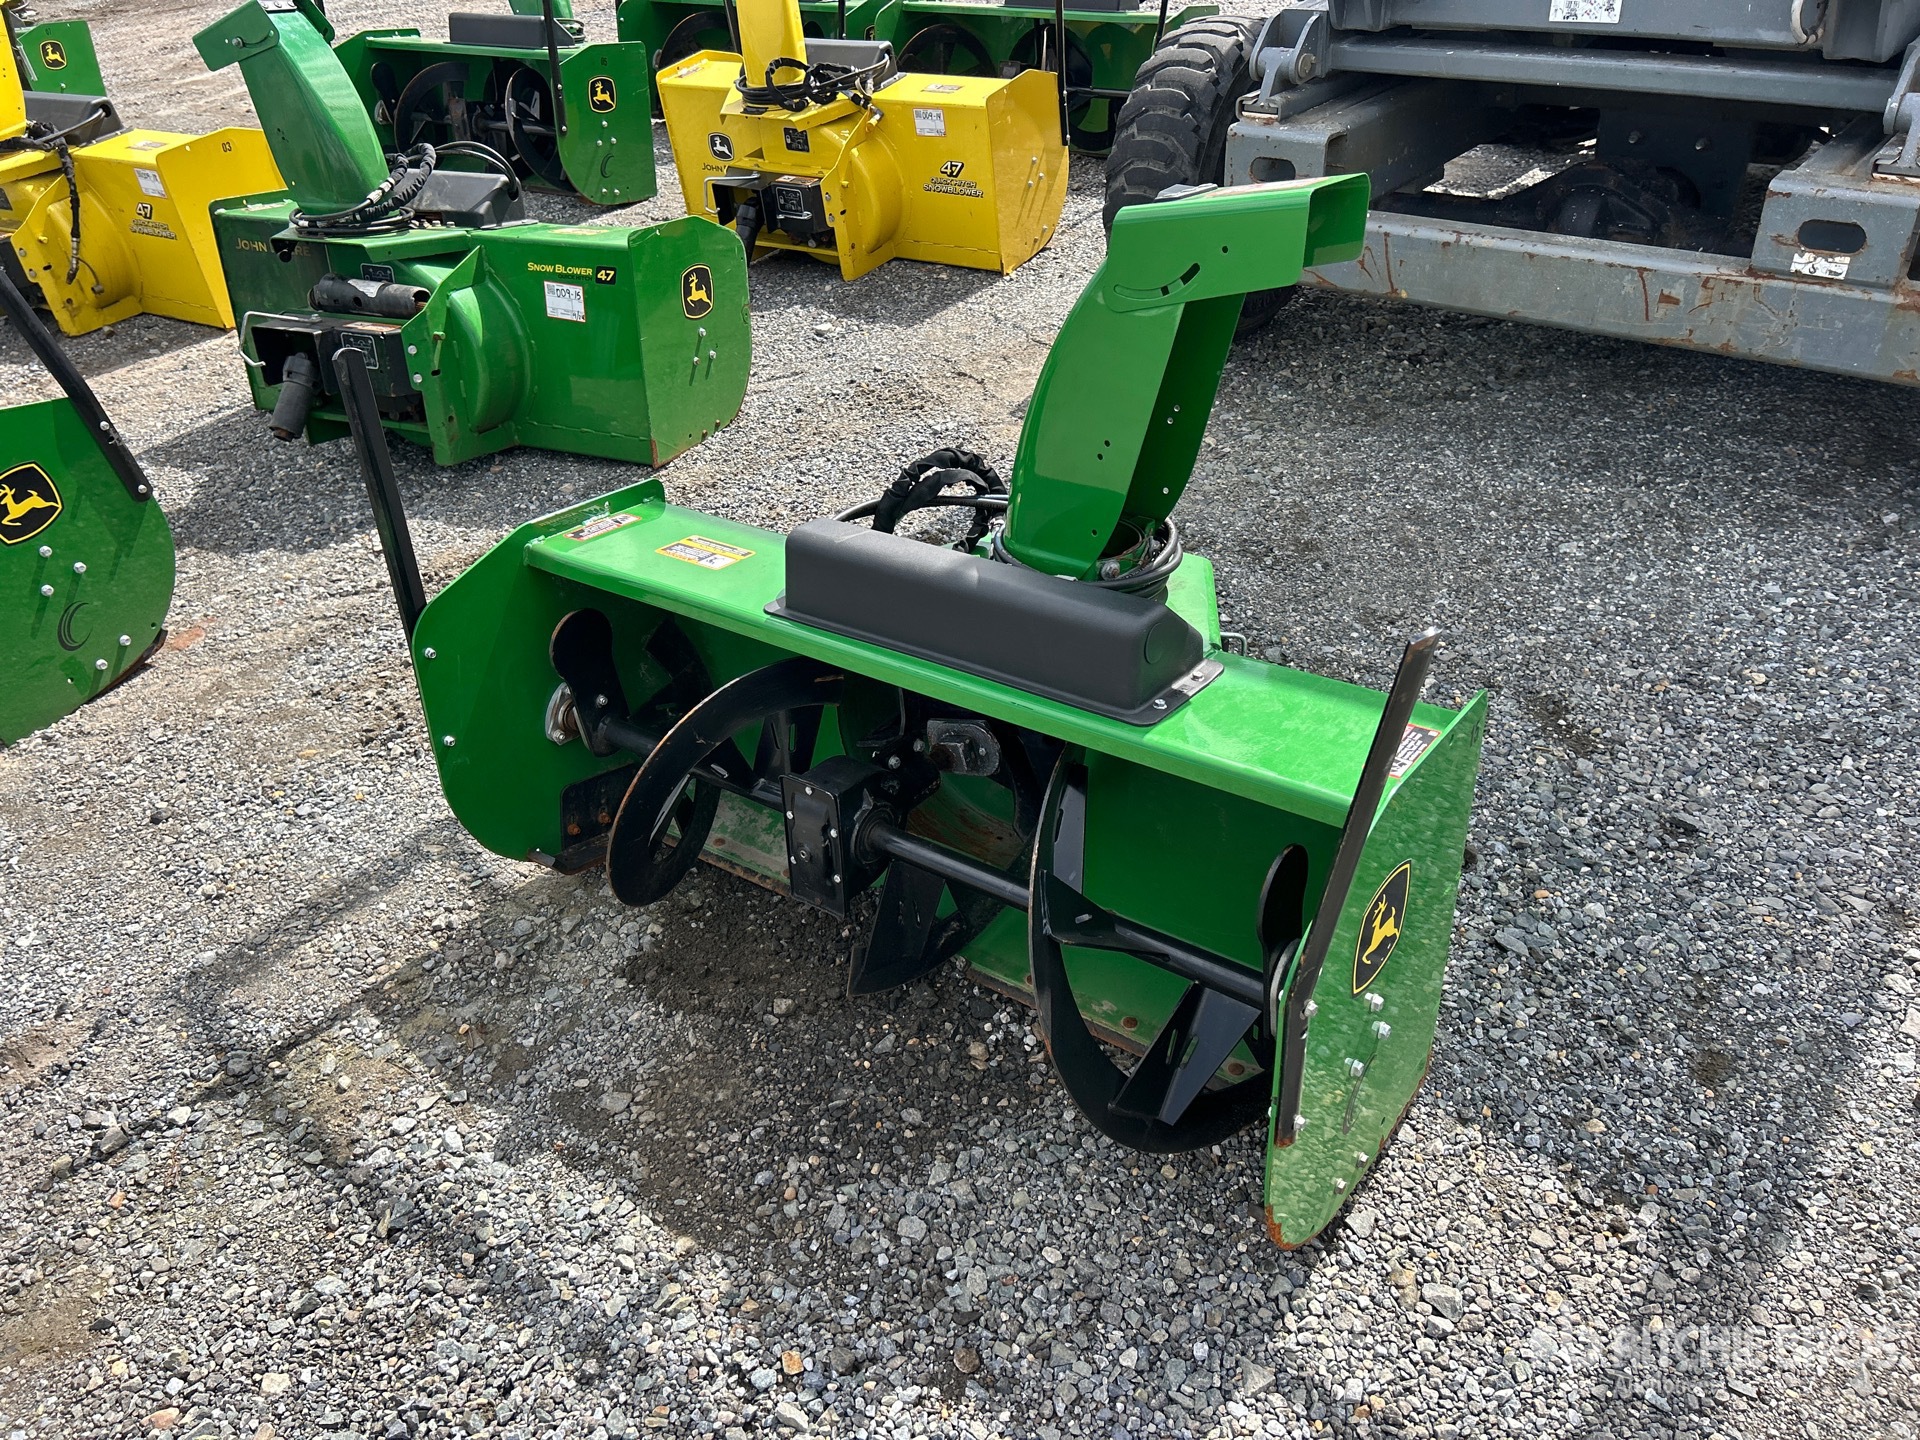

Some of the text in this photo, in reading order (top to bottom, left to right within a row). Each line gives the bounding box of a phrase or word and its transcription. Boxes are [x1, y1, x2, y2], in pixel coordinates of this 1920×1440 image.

[221, 141, 232, 152] 03
[702, 163, 723, 172] JOHN
[940, 160, 964, 178] 47
[930, 177, 977, 188] QUICK HITCH
[923, 183, 984, 198] SNOWBLOWER
[136, 202, 153, 219] 47
[235, 237, 268, 253] JOHN
[597, 270, 615, 282] 47
[556, 288, 581, 300] 009-15
